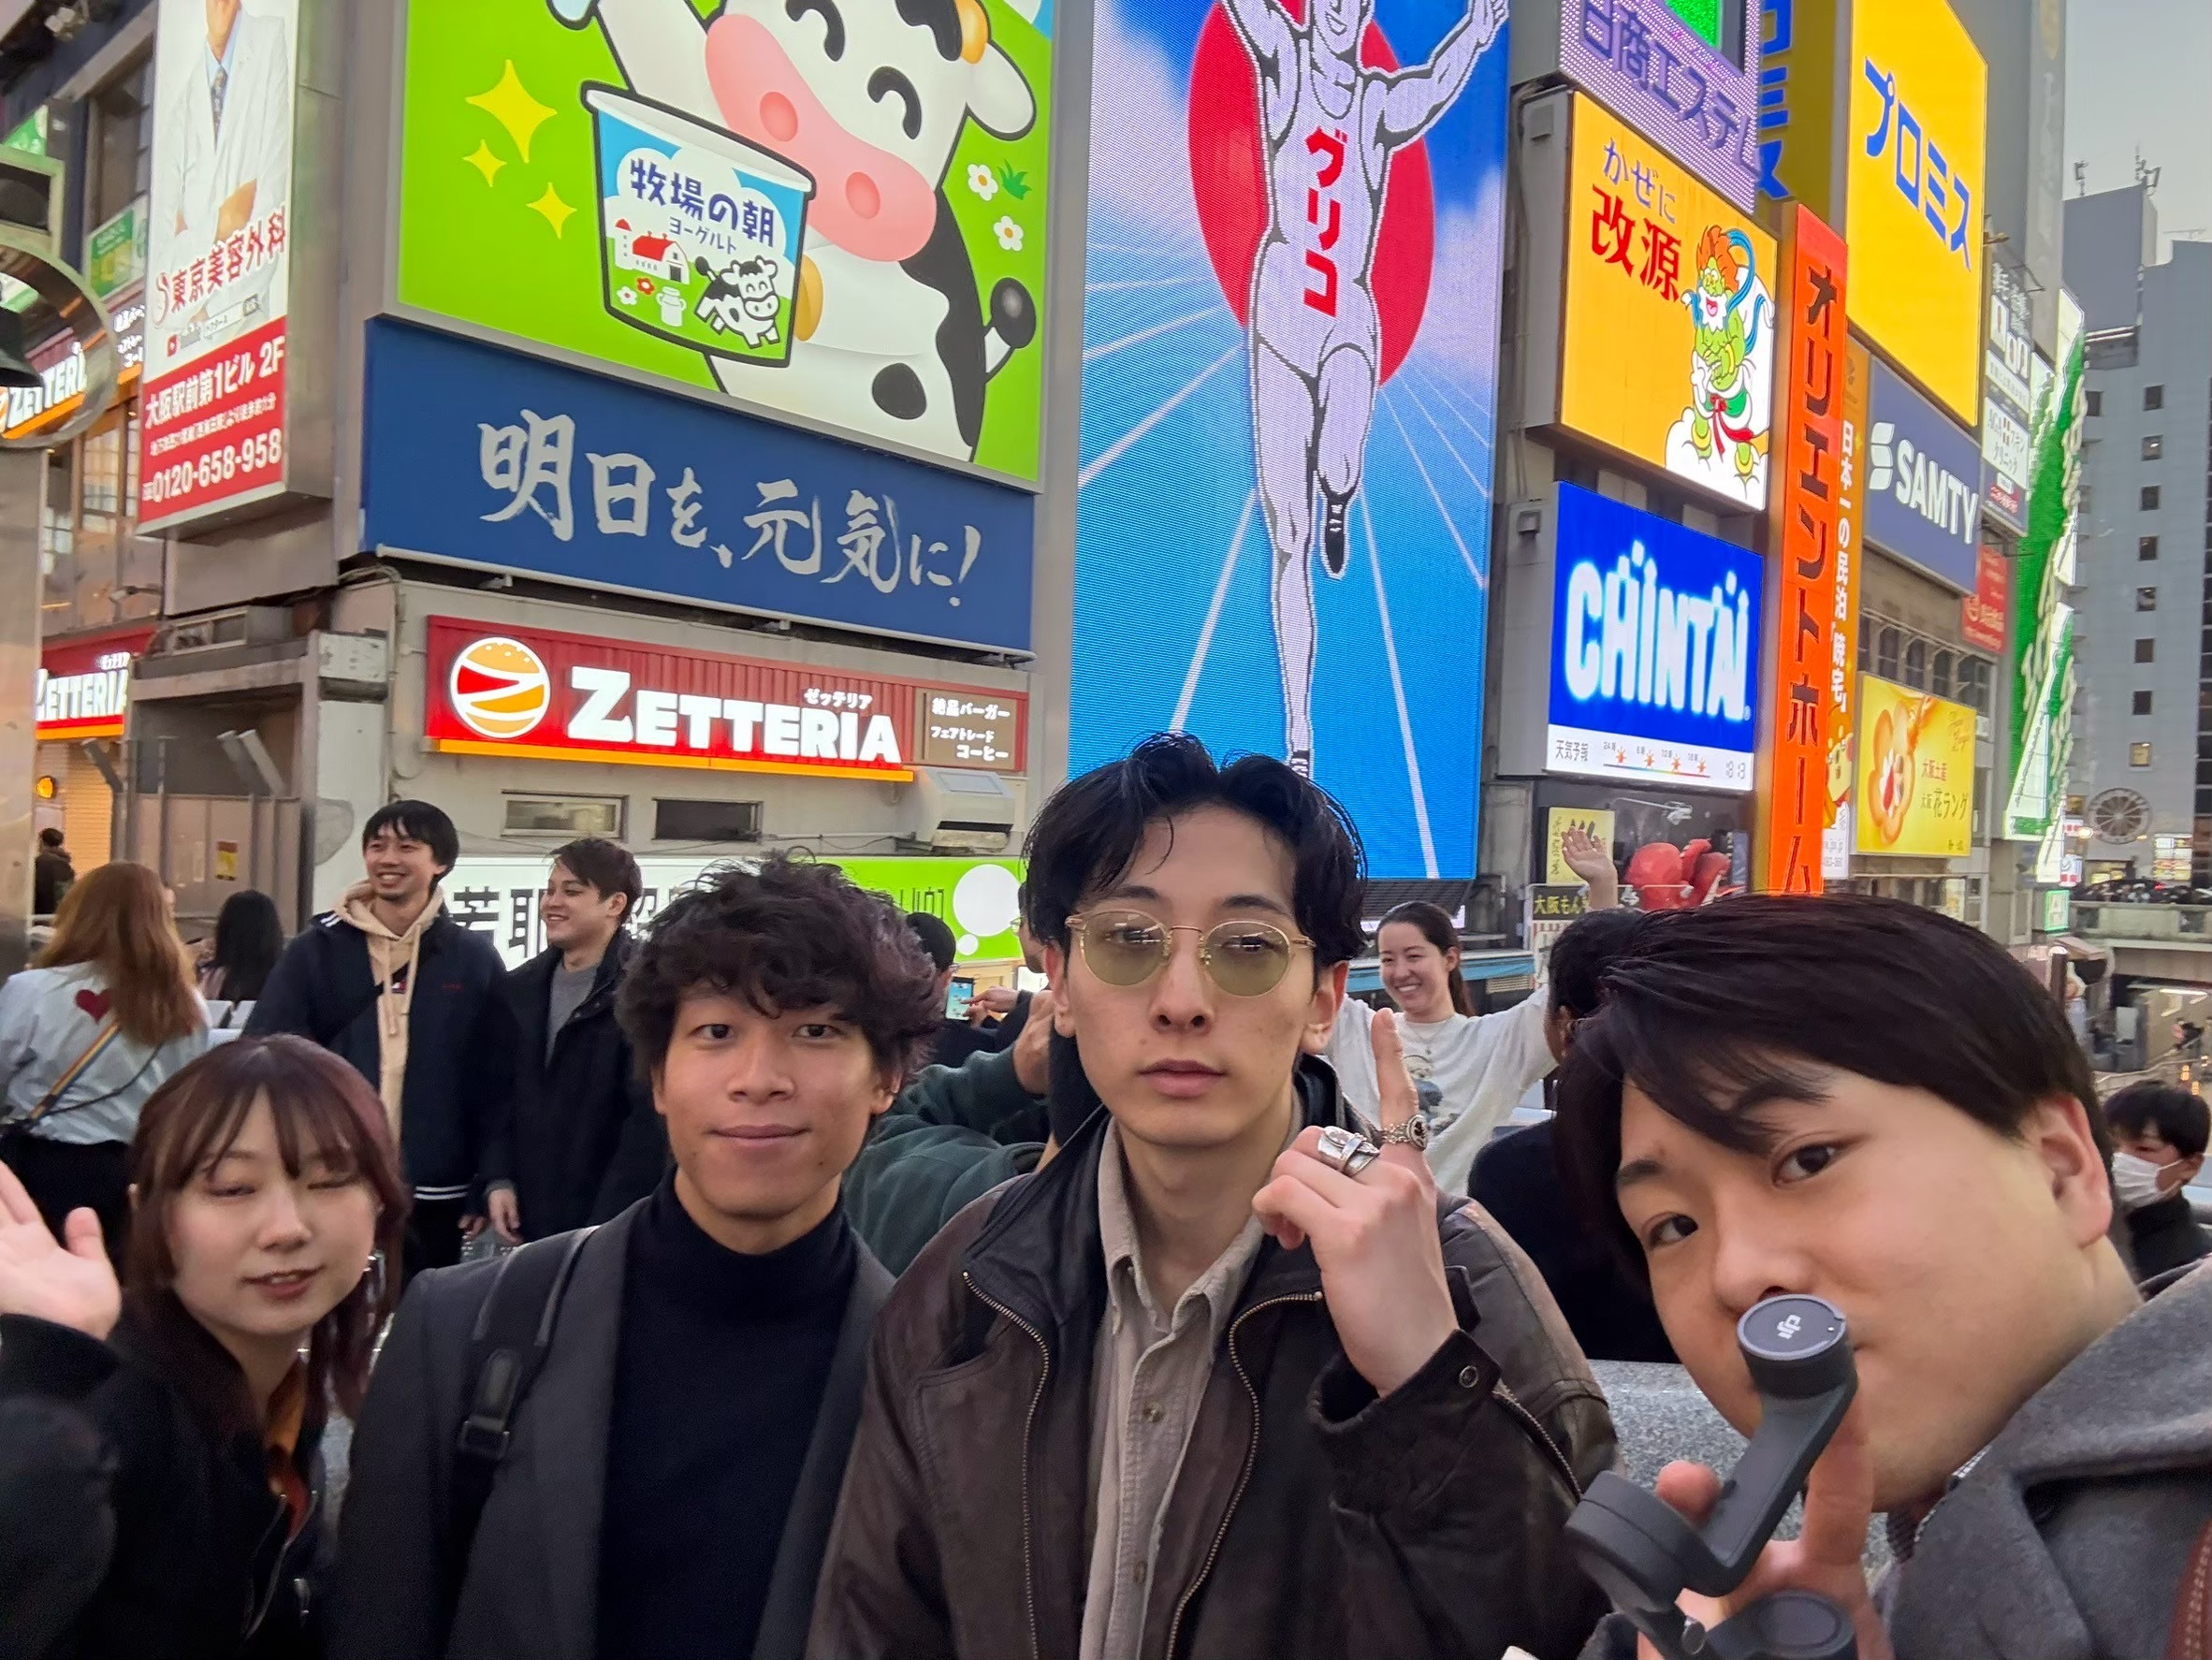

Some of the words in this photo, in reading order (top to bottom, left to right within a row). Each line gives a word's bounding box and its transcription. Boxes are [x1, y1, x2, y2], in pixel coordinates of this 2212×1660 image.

[630, 158, 775, 248] 牧場の朝
[1604, 137, 1676, 224] かぜに
[1865, 56, 1972, 272] プロミス
[171, 205, 286, 313] 東京美容外科
[669, 216, 737, 255] ヨーグルト
[1303, 125, 1347, 318] グリコ
[1592, 183, 1683, 303] 改源
[145, 352, 256, 430] 大阪駅前第1ビル
[258, 335, 286, 379] 2F
[153, 428, 283, 502] 0120-658-958
[1896, 439, 1979, 545] SAMTY
[567, 665, 902, 764] ZETTERIA
[804, 688, 873, 710] ゼッテリア
[930, 725, 996, 743] フェアトレード
[956, 744, 1010, 762] コーヒー
